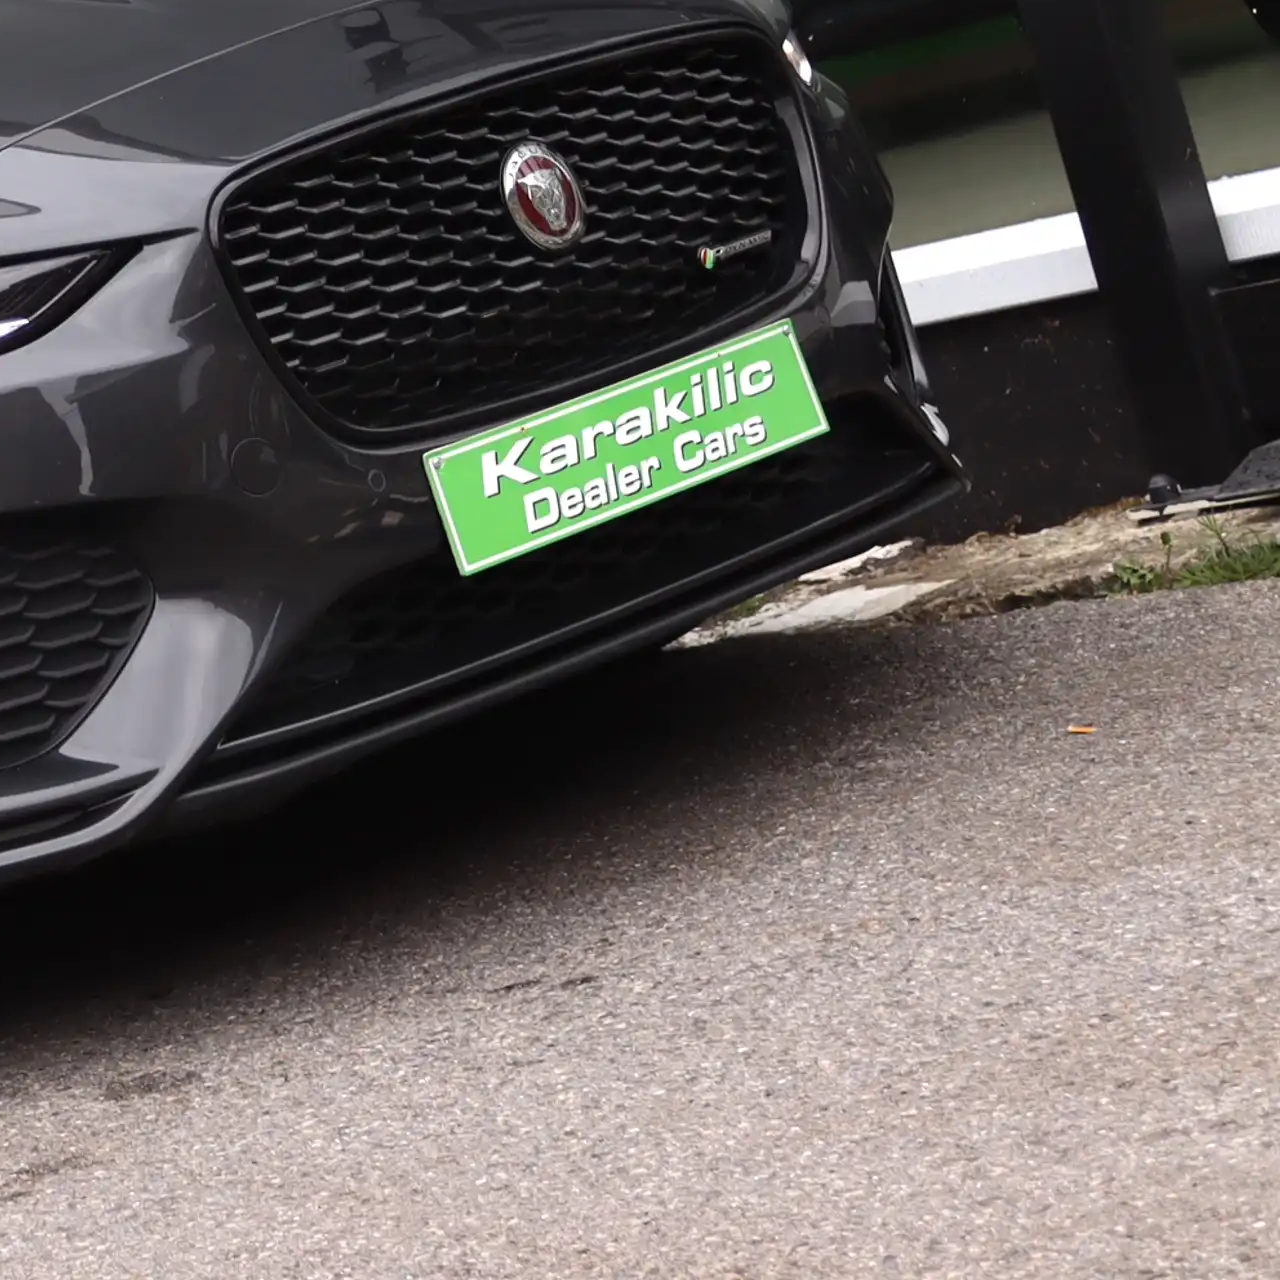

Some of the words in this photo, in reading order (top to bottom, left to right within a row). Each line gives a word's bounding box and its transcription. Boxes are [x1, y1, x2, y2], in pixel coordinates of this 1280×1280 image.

[481, 360, 775, 497] Karakilic
[523, 454, 662, 534] Dealer
[673, 415, 767, 473] Cars
